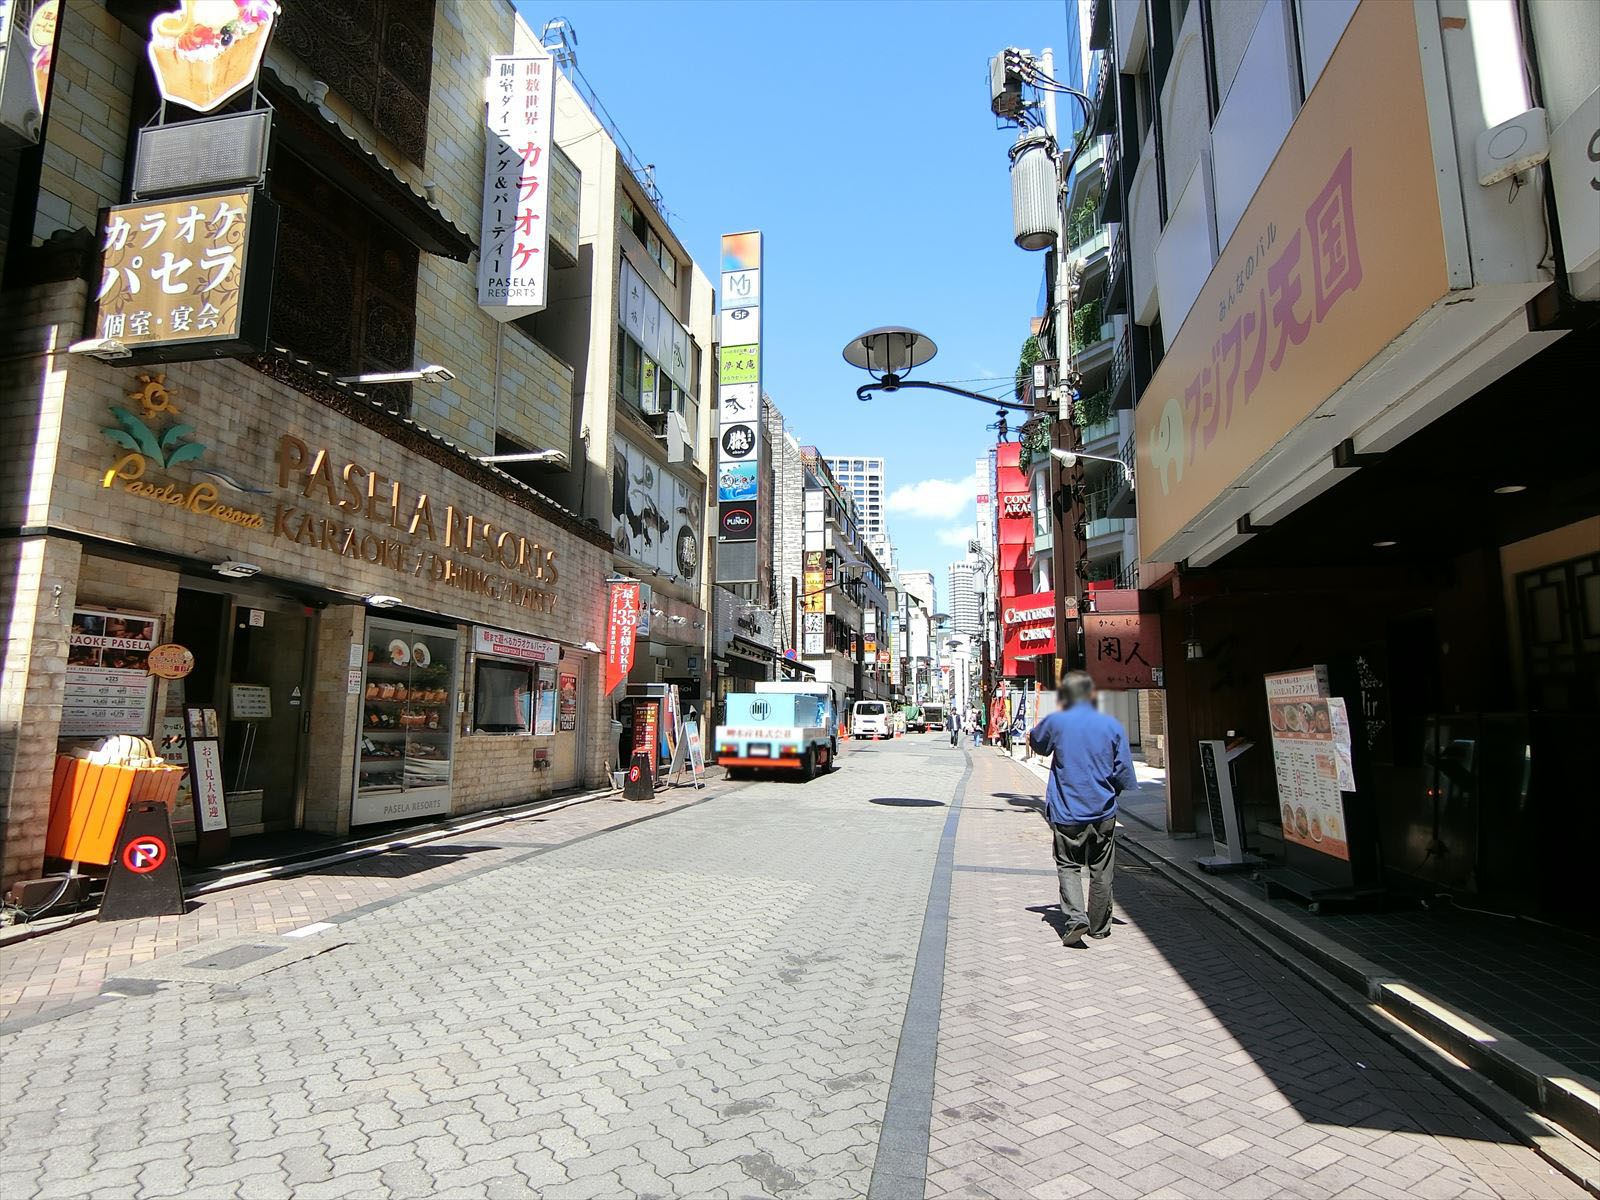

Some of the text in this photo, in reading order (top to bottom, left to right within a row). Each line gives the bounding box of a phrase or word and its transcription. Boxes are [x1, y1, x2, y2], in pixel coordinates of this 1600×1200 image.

[512, 62, 541, 271] 曲数世界 カラオケ
[101, 202, 244, 252] カラオケ
[94, 246, 237, 302] パセラ
[488, 278, 536, 287] PASELA
[488, 289, 536, 297] RESORTS
[1218, 222, 1278, 322] みんなのバル
[103, 303, 220, 338] 個室・宴会
[734, 311, 748, 319] 5F
[1184, 146, 1363, 466] アジアン天国
[103, 453, 265, 529] Pasela Resorts
[278, 434, 559, 586] PASELA RESORTS
[273, 503, 404, 572] KARAOKE
[431, 554, 497, 600] DINING
[509, 580, 558, 614] PARTY
[111, 638, 152, 650] PASELA
[1098, 636, 1150, 666] 閑人
[561, 722, 575, 730] TOAST
[202, 746, 219, 818] お下見大歓迎
[384, 800, 441, 815] PASELA RESORTS
